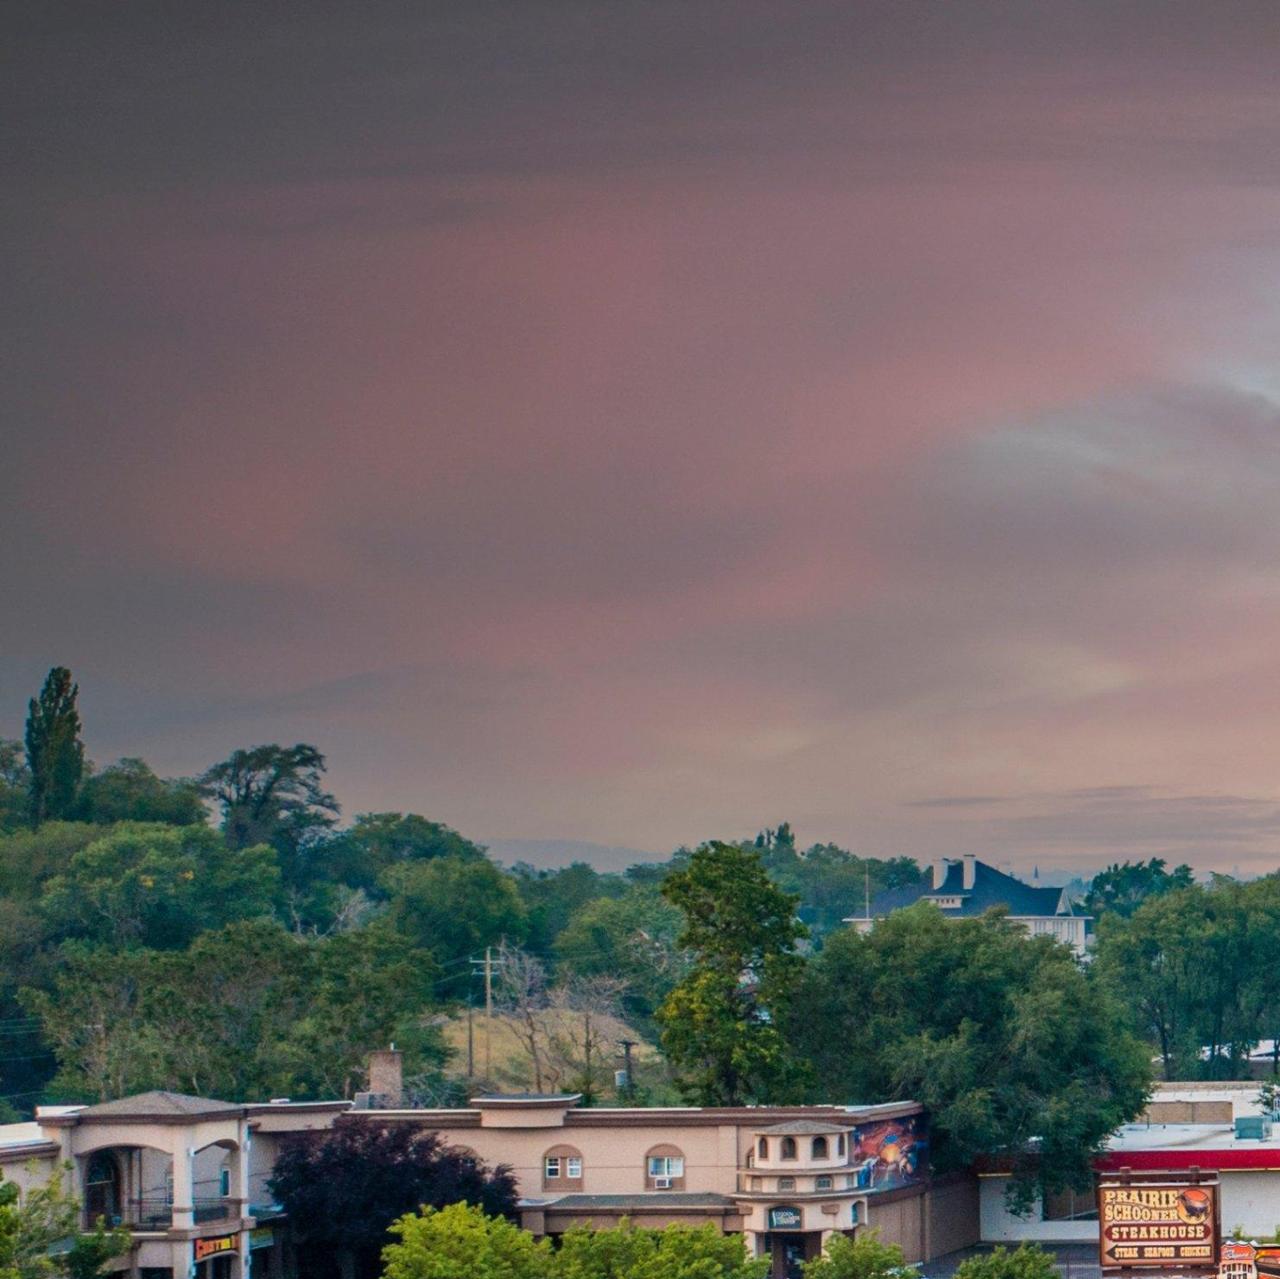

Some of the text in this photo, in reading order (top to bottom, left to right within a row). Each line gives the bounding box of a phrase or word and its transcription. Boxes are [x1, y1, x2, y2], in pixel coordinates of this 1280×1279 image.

[1104, 1190, 1178, 1208] PRAIRIE
[1104, 1204, 1178, 1221] SCHOONER
[1111, 1225, 1204, 1239] STEAKHOUSE
[1115, 1247, 1139, 1258] STEAK
[1144, 1247, 1175, 1258] SEAFOOD
[1180, 1246, 1211, 1257] CHICKEN
